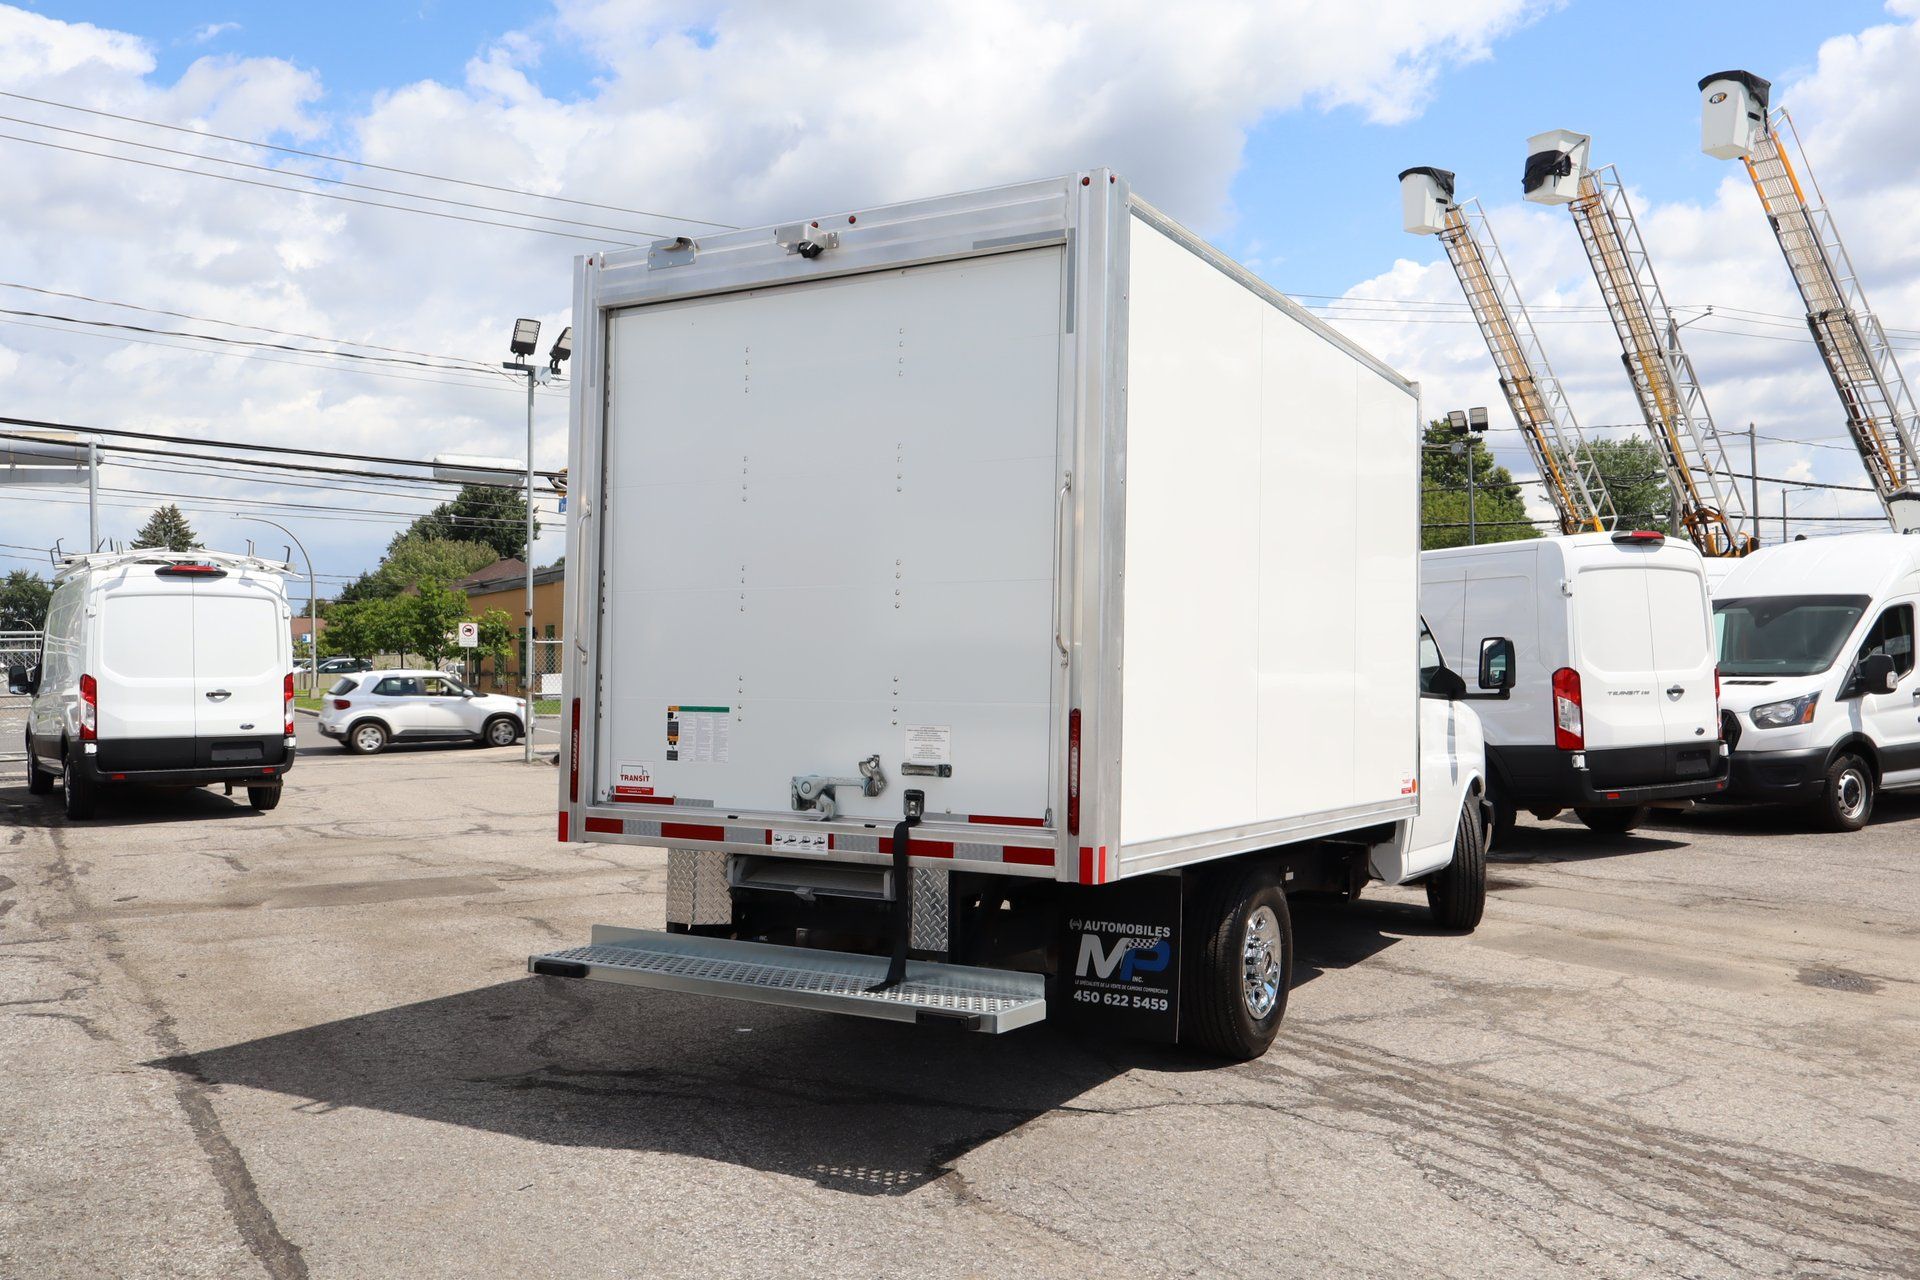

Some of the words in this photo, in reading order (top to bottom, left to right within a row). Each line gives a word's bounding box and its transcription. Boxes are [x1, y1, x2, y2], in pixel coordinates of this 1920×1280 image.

[620, 774, 650, 782] TRANSIT
[1083, 920, 1171, 938] AUTOMOBILES
[1075, 933, 1171, 982] MP
[1132, 975, 1144, 983] INC.
[1073, 989, 1100, 1003] 450
[1103, 992, 1129, 1007] 622
[1132, 996, 1168, 1011] 5459
